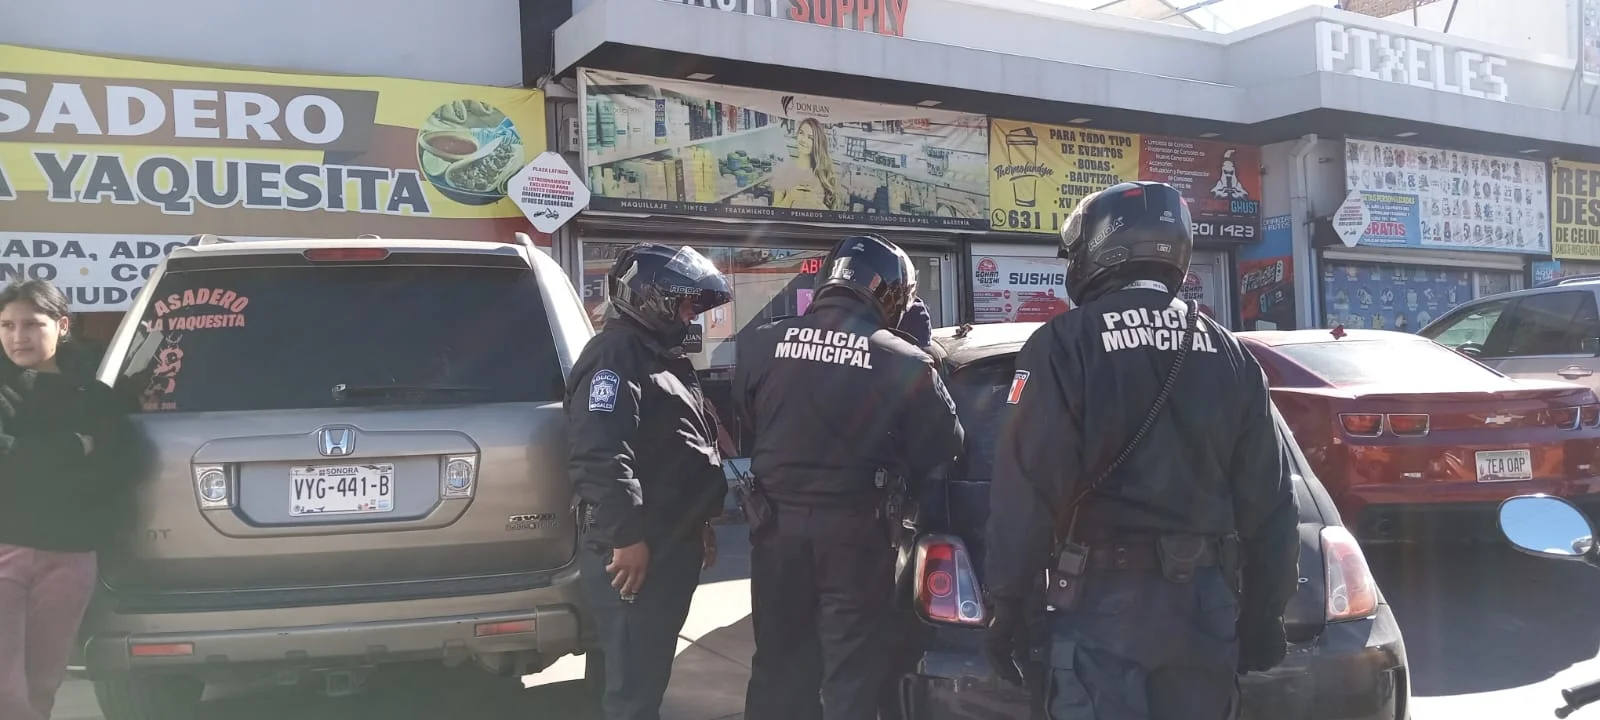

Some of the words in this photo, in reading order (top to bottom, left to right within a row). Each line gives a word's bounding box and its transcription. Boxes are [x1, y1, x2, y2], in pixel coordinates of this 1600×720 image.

[1315, 20, 1508, 102] PIXELES
[796, 102, 811, 111] DON
[811, 104, 830, 113] JUAN
[1050, 129, 1076, 141] PARA
[1079, 131, 1105, 145] TODO
[1108, 135, 1131, 147] TIPO
[1061, 143, 1075, 155] DE
[1078, 145, 1123, 159] EVENTOS
[1078, 158, 1110, 171] BODAS
[31, 149, 430, 215] YAQUESITA
[1070, 171, 1119, 185] BAUTIZOS
[621, 202, 667, 210] MAQUILLAJE
[725, 207, 775, 216] TRATAMIENTOS
[1059, 197, 1071, 209] XV
[1008, 209, 1040, 229] 631
[1557, 197, 1600, 226] DES
[1220, 224, 1254, 237] 1423
[1556, 227, 1568, 242] DE
[1009, 273, 1065, 285] SUSHIS
[154, 288, 249, 317] ASADERO
[146, 319, 163, 332] LA
[168, 314, 245, 331] YAQUESITA
[784, 327, 869, 351] POLICIA
[774, 342, 872, 369] MUNICIPAL
[326, 467, 359, 475] SONORA
[1486, 459, 1504, 474] 7EA
[294, 475, 389, 500] VYG-441-B
